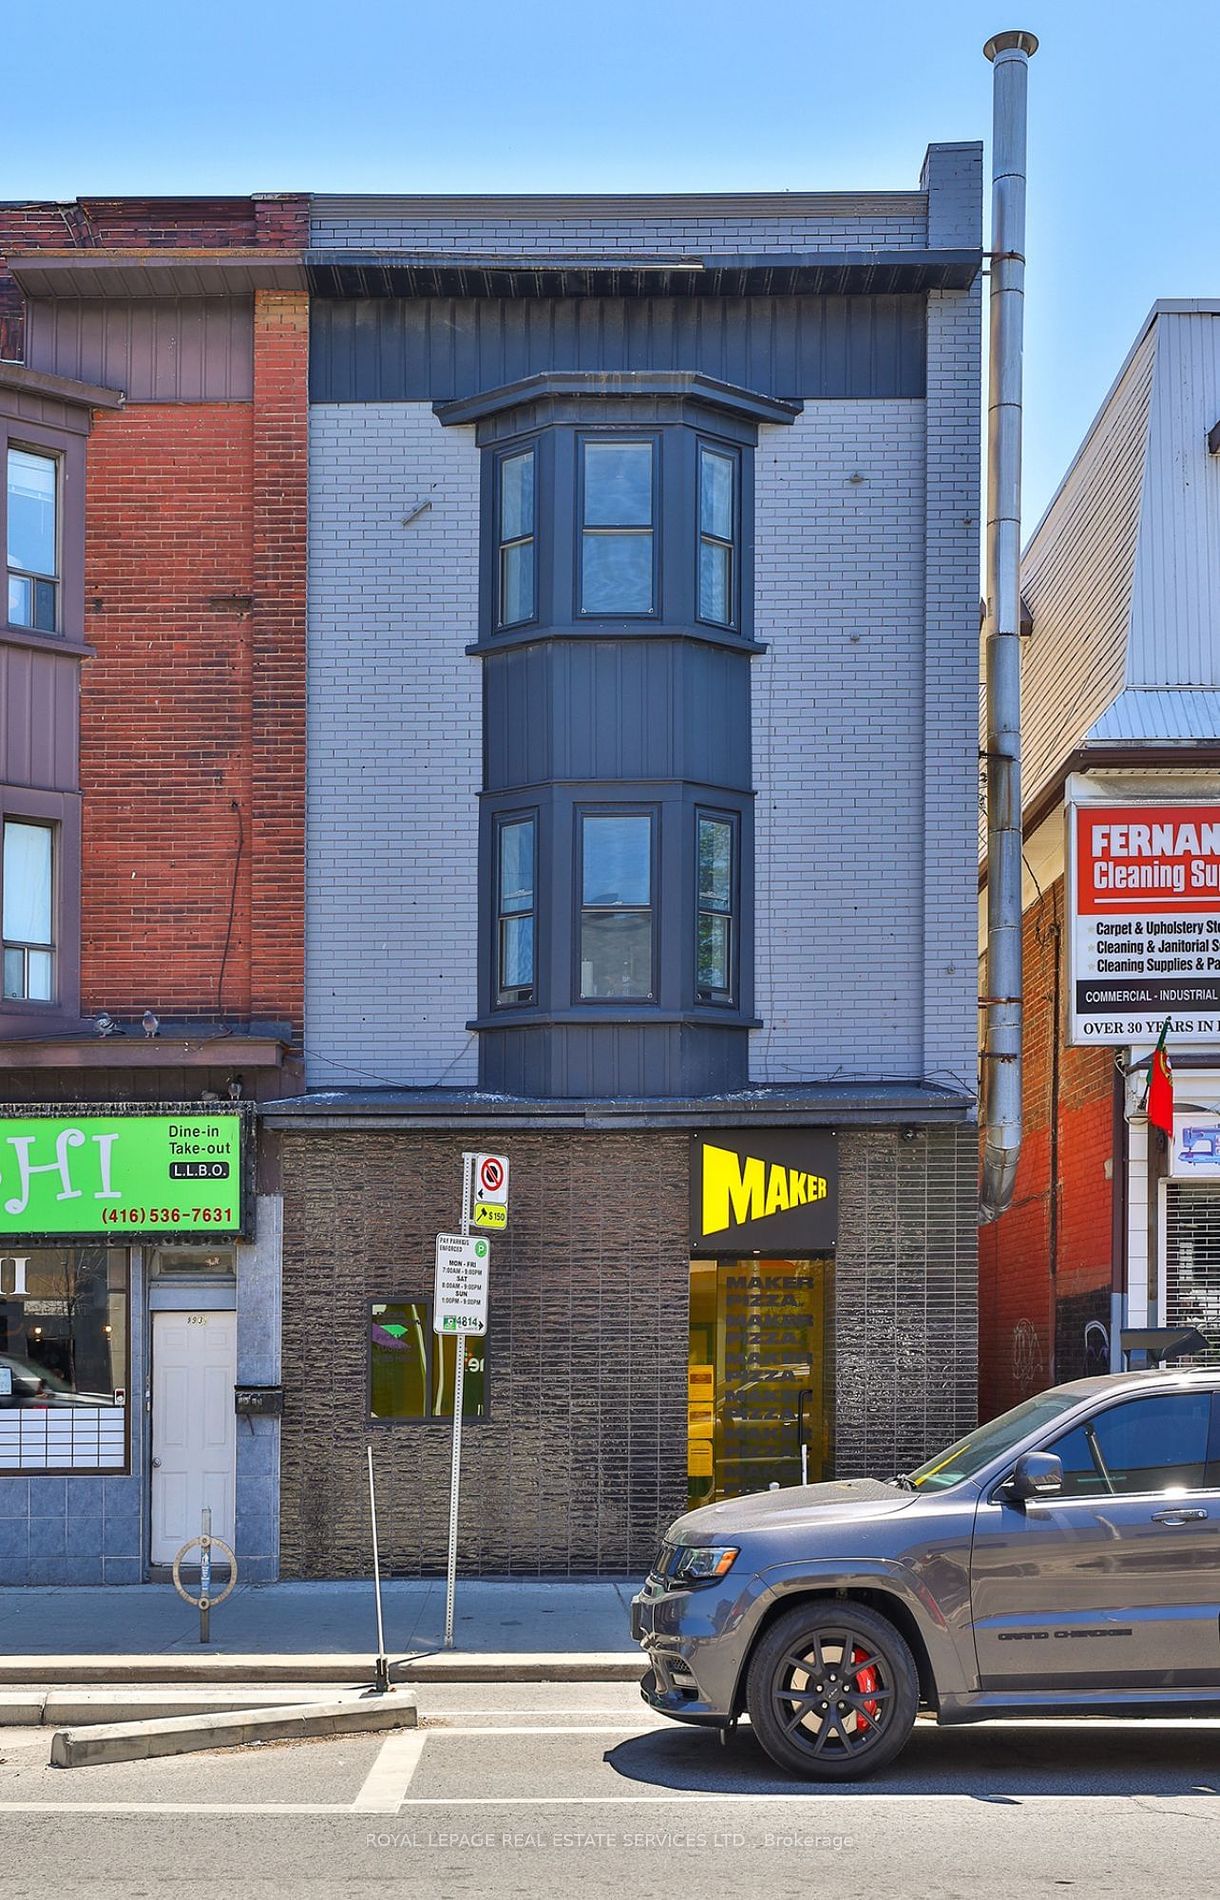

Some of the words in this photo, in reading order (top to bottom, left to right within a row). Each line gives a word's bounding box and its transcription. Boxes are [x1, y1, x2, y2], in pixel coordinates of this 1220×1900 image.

[1092, 823, 1220, 857] FERNAN
[1093, 860, 1186, 893] Cleaning
[1190, 859, 1220, 892] Su
[1096, 921, 1132, 937] Carpet
[1134, 921, 1144, 935] &
[1146, 920, 1204, 936] Upholstery
[1096, 940, 1144, 955] Cleaning
[1146, 939, 1156, 953] &
[1157, 938, 1209, 953] Janitorial
[1211, 938, 1220, 952] S
[1097, 958, 1145, 973] Cleaning
[1146, 957, 1193, 973] Supplies
[1195, 956, 1205, 971] &
[1085, 990, 1153, 1003] COMMERCIAL
[1159, 988, 1219, 1002] INDUSTRIAL
[1083, 1022, 1125, 1035] OVER
[1127, 1021, 1143, 1034] 30
[1197, 1019, 1214, 1033] IN
[168, 1125, 220, 1138] Dine-in
[168, 1141, 232, 1155] Take-out
[174, 1164, 227, 1177] L.L.B.O.
[702, 1142, 828, 1237] MAKER
[726, 1276, 814, 1290] MAKER
[456, 1315, 478, 1328] 4814
